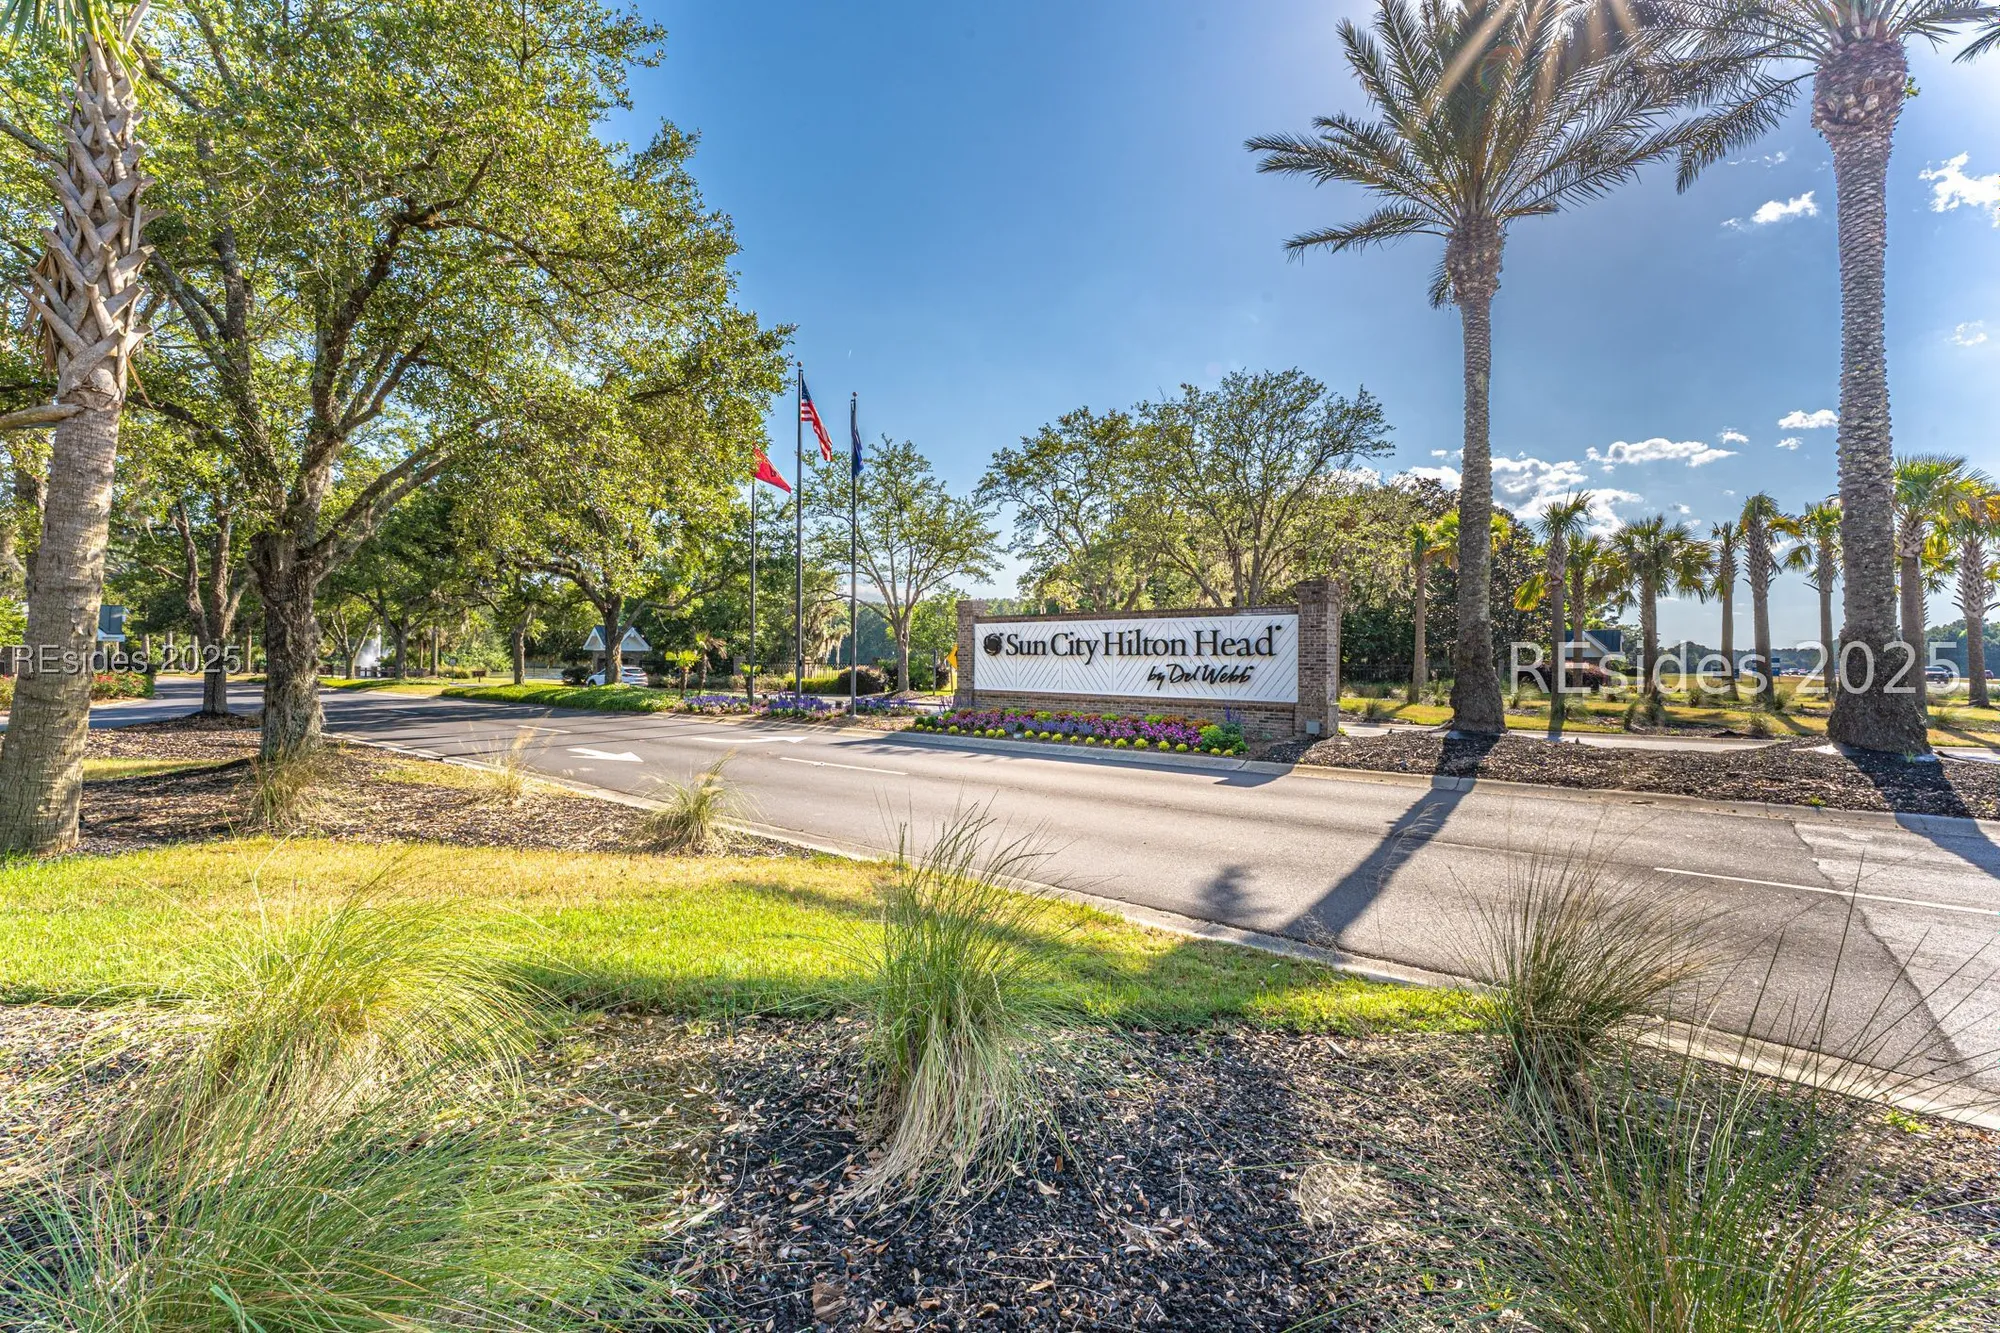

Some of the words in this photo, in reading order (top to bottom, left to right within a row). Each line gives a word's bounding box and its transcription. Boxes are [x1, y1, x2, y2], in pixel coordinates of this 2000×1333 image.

[1005, 633, 1046, 656] Sun
[1050, 631, 1099, 665] City
[1104, 629, 1187, 656] Hilton
[1193, 626, 1277, 657] Head
[1147, 665, 1164, 691] by
[1166, 663, 1200, 684] Del
[1202, 664, 1251, 685] Webb
